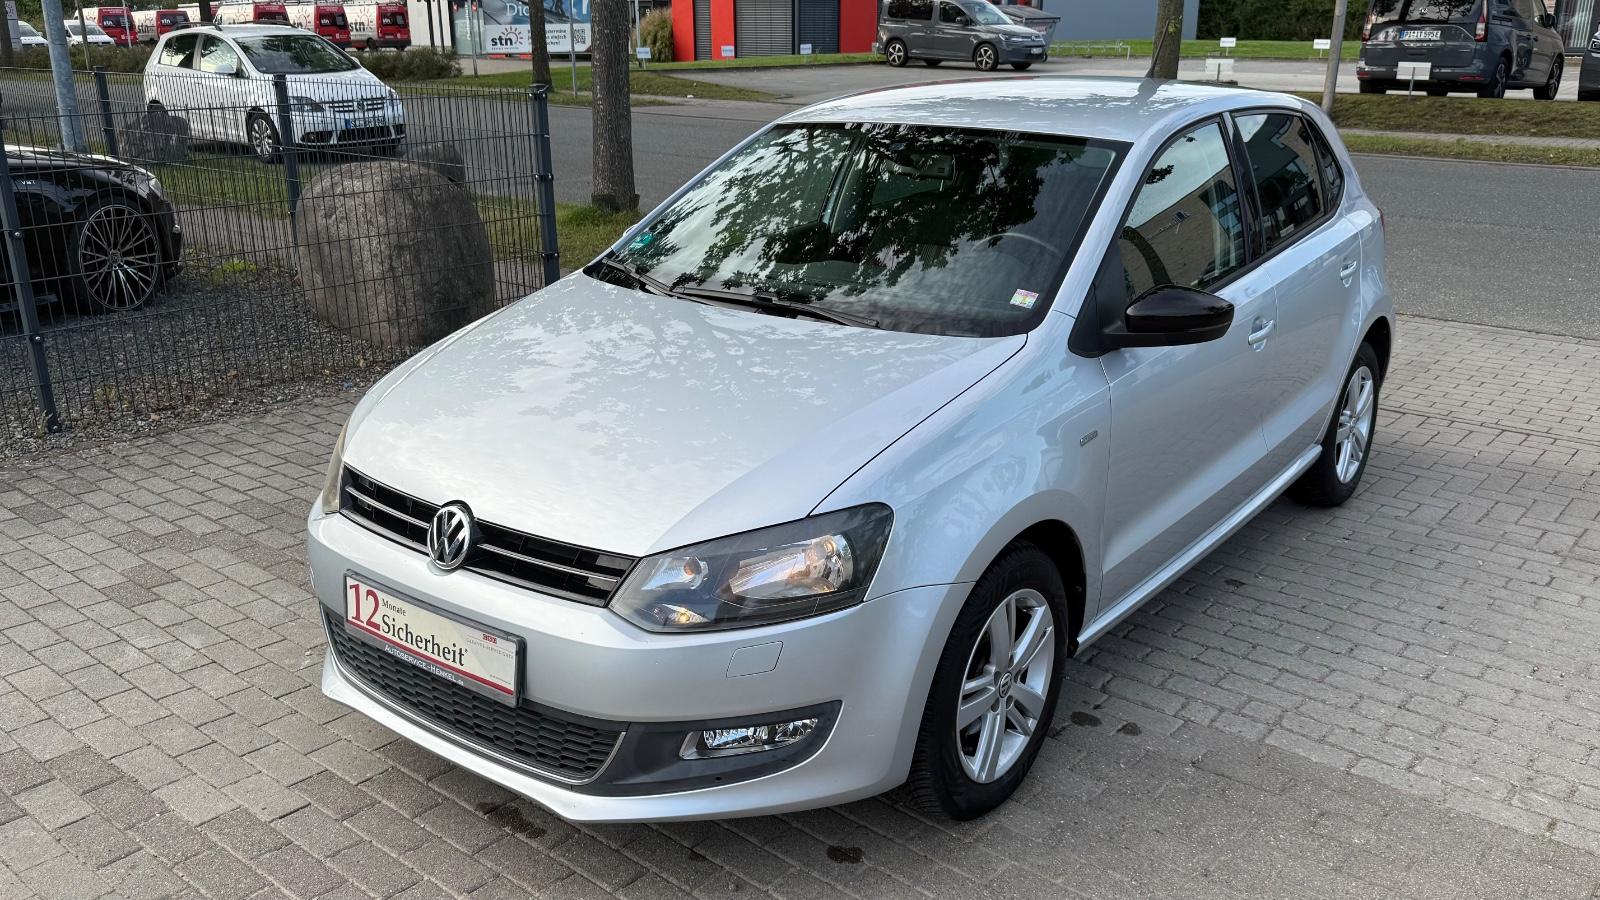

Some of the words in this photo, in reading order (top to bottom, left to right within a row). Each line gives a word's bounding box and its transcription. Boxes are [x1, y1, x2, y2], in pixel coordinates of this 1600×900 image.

[491, 35, 513, 46] stn
[349, 583, 381, 632] 12
[381, 598, 407, 617] Monate
